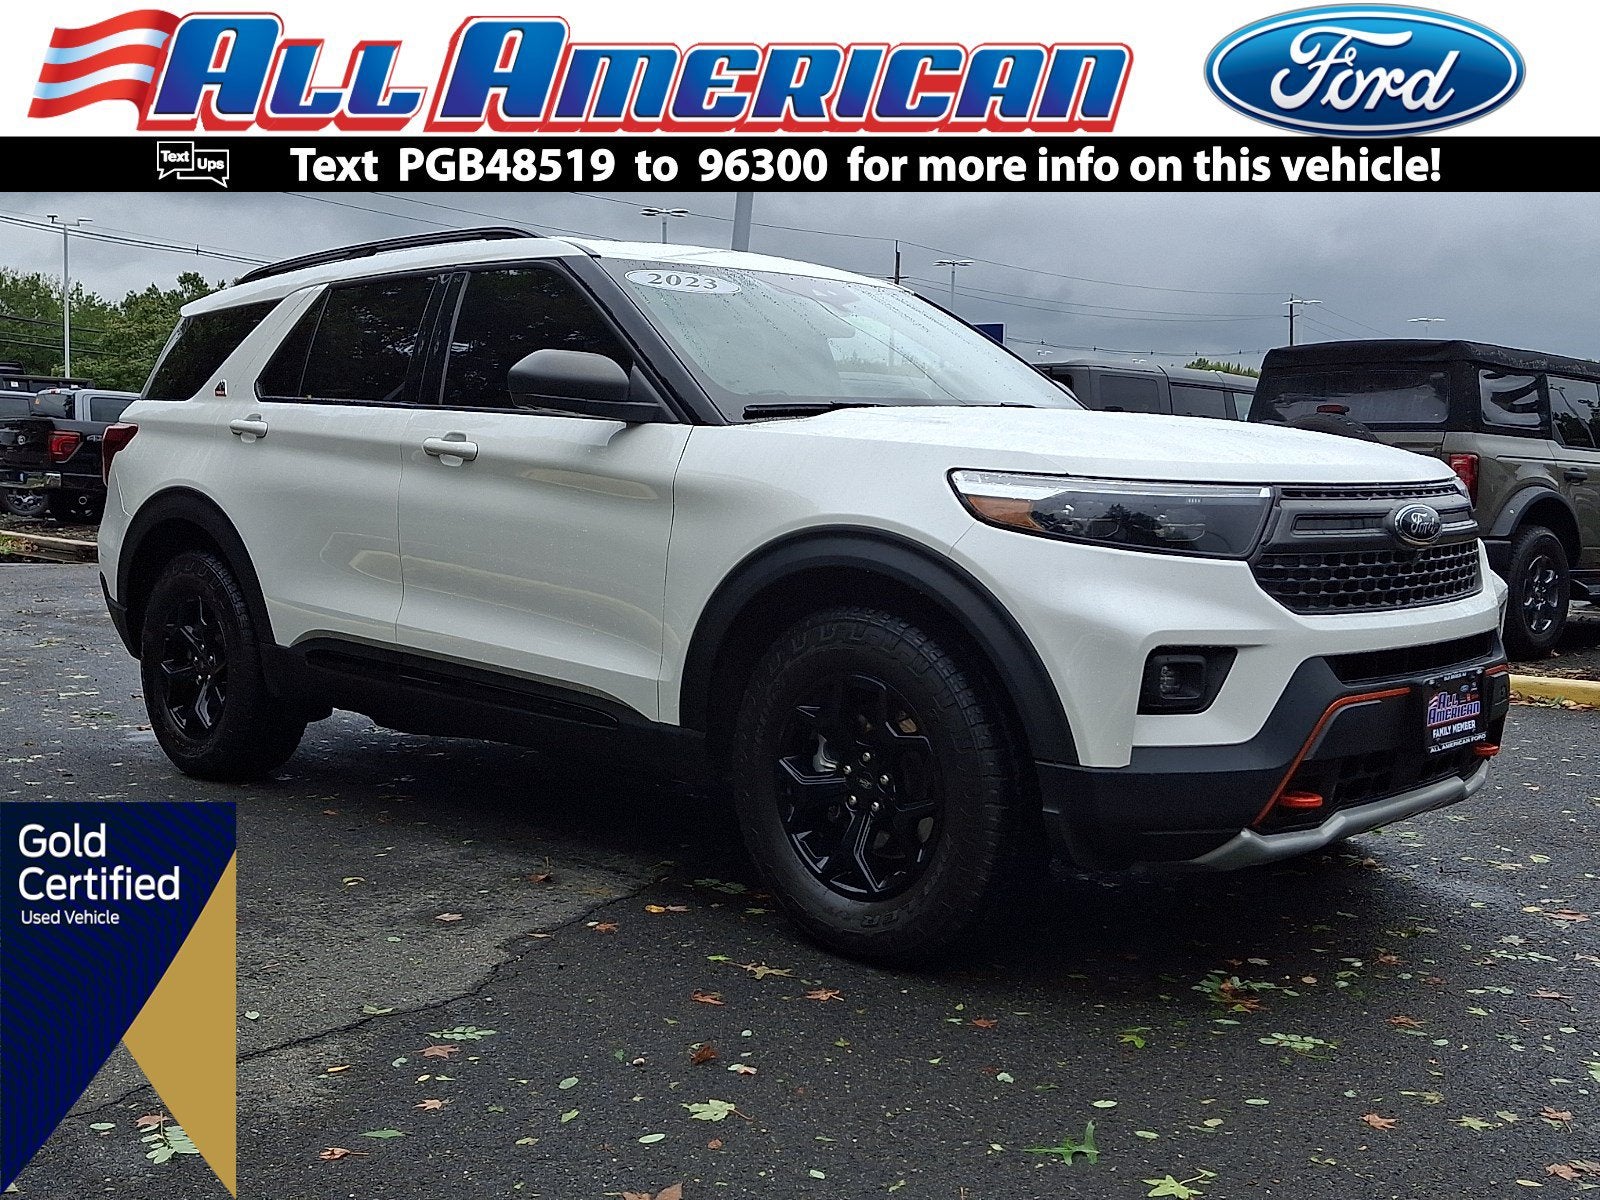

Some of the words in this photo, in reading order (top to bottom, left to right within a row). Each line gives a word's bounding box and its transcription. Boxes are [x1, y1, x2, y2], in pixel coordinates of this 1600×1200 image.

[647, 273, 718, 289] 2023
[1411, 512, 1437, 535] Ford
[1432, 725, 1452, 739] FAMILY
[1452, 720, 1476, 734] MEMBER
